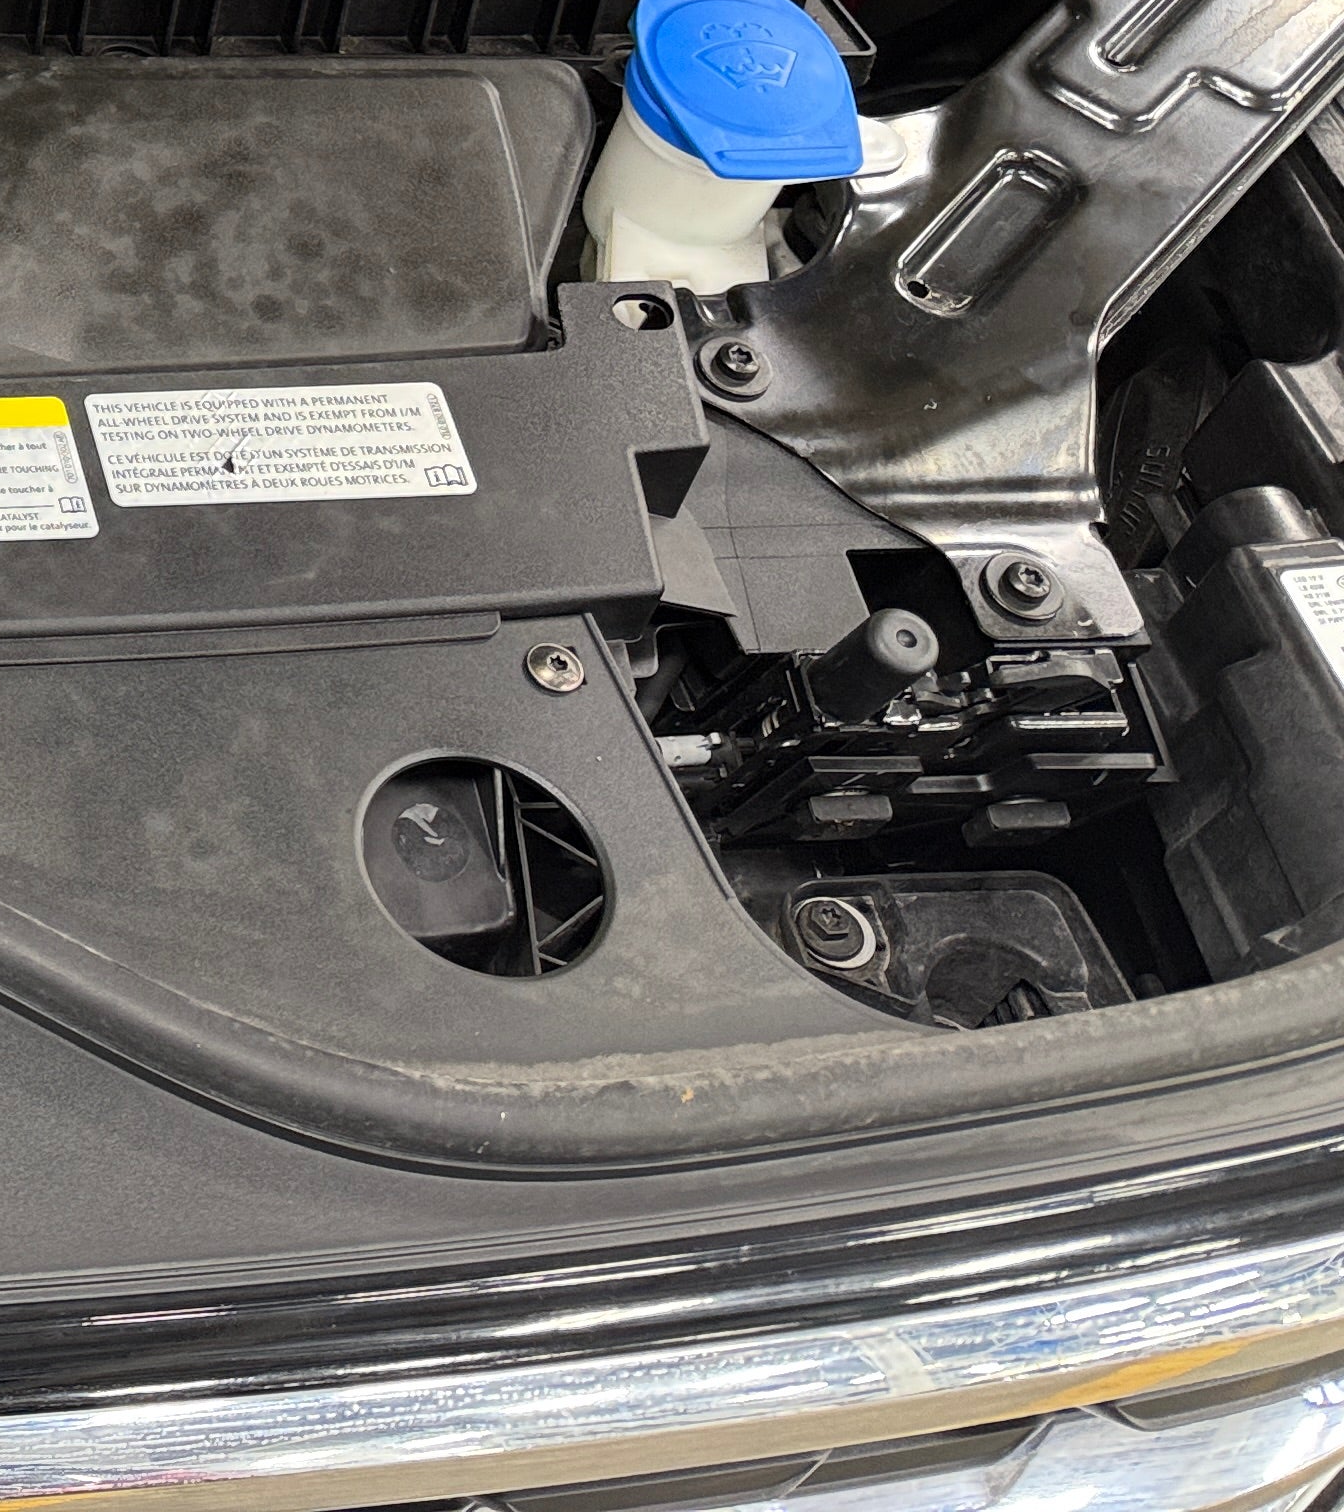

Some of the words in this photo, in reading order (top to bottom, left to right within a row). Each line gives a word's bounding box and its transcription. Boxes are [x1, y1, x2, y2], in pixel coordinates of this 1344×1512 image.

[92, 403, 123, 413] THIS
[123, 400, 177, 412] VEHICLE
[179, 400, 192, 410] IS
[260, 397, 296, 407] WITH
[300, 397, 309, 406] A
[97, 415, 169, 427] ALL-WHEEL
[170, 414, 209, 425] DRIVE
[211, 412, 260, 424] SYSTEM
[263, 411, 291, 421] AND
[294, 411, 307, 420] IS
[308, 409, 356, 420] EXEMPT
[360, 407, 397, 418] FROM
[399, 406, 421, 416] I/M
[99, 430, 155, 441] TESTING
[157, 429, 178, 439] ON
[180, 426, 263, 439] TWO-WHEEL
[264, 425, 303, 436] DRIVE
[305, 421, 414, 434] DYNAMOMETERS.
[107, 454, 124, 464] CE
[189, 450, 210, 463] EST
[339, 446, 357, 456] DE
[358, 443, 452, 455] TRANSMISSION
[256, 463, 271, 474] ET
[329, 459, 381, 471] D'ESSAIS
[382, 458, 415, 469] D'I/M
[115, 482, 141, 493] SUR
[261, 477, 298, 488] DEUX
[299, 475, 343, 487] ROUES
[344, 473, 409, 485] MOTRICES.
